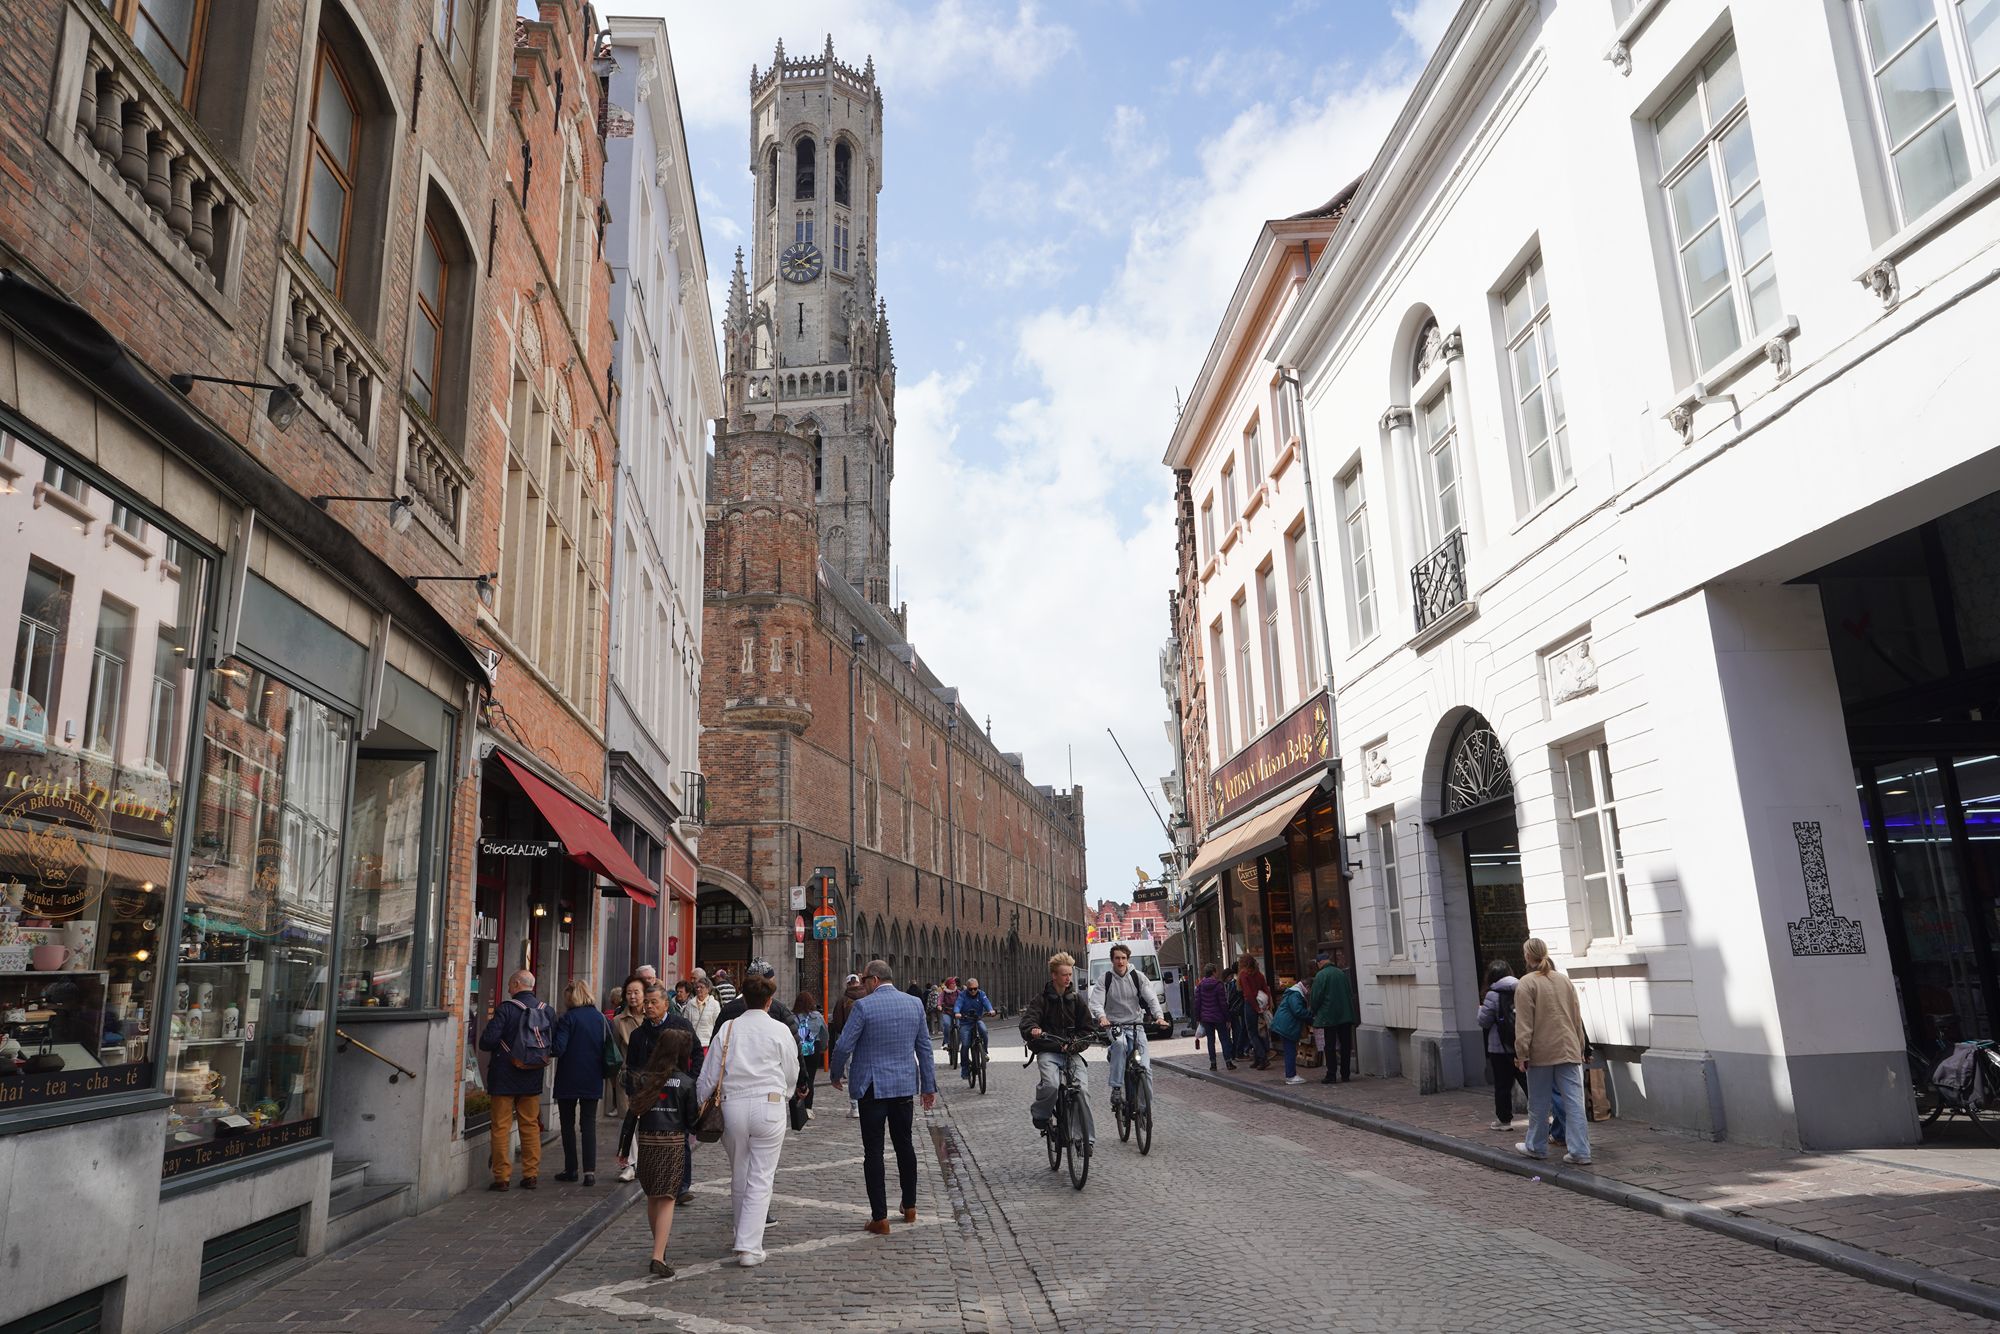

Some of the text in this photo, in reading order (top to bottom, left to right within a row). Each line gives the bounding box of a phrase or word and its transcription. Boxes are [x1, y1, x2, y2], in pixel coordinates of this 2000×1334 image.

[1287, 733, 1313, 765] Belge
[5, 802, 27, 829] HET
[30, 796, 65, 810] BRUGS
[46, 1079, 67, 1096] tea
[86, 1072, 109, 1090] cha
[126, 1068, 138, 1085] té
[195, 1147, 213, 1165] Tee
